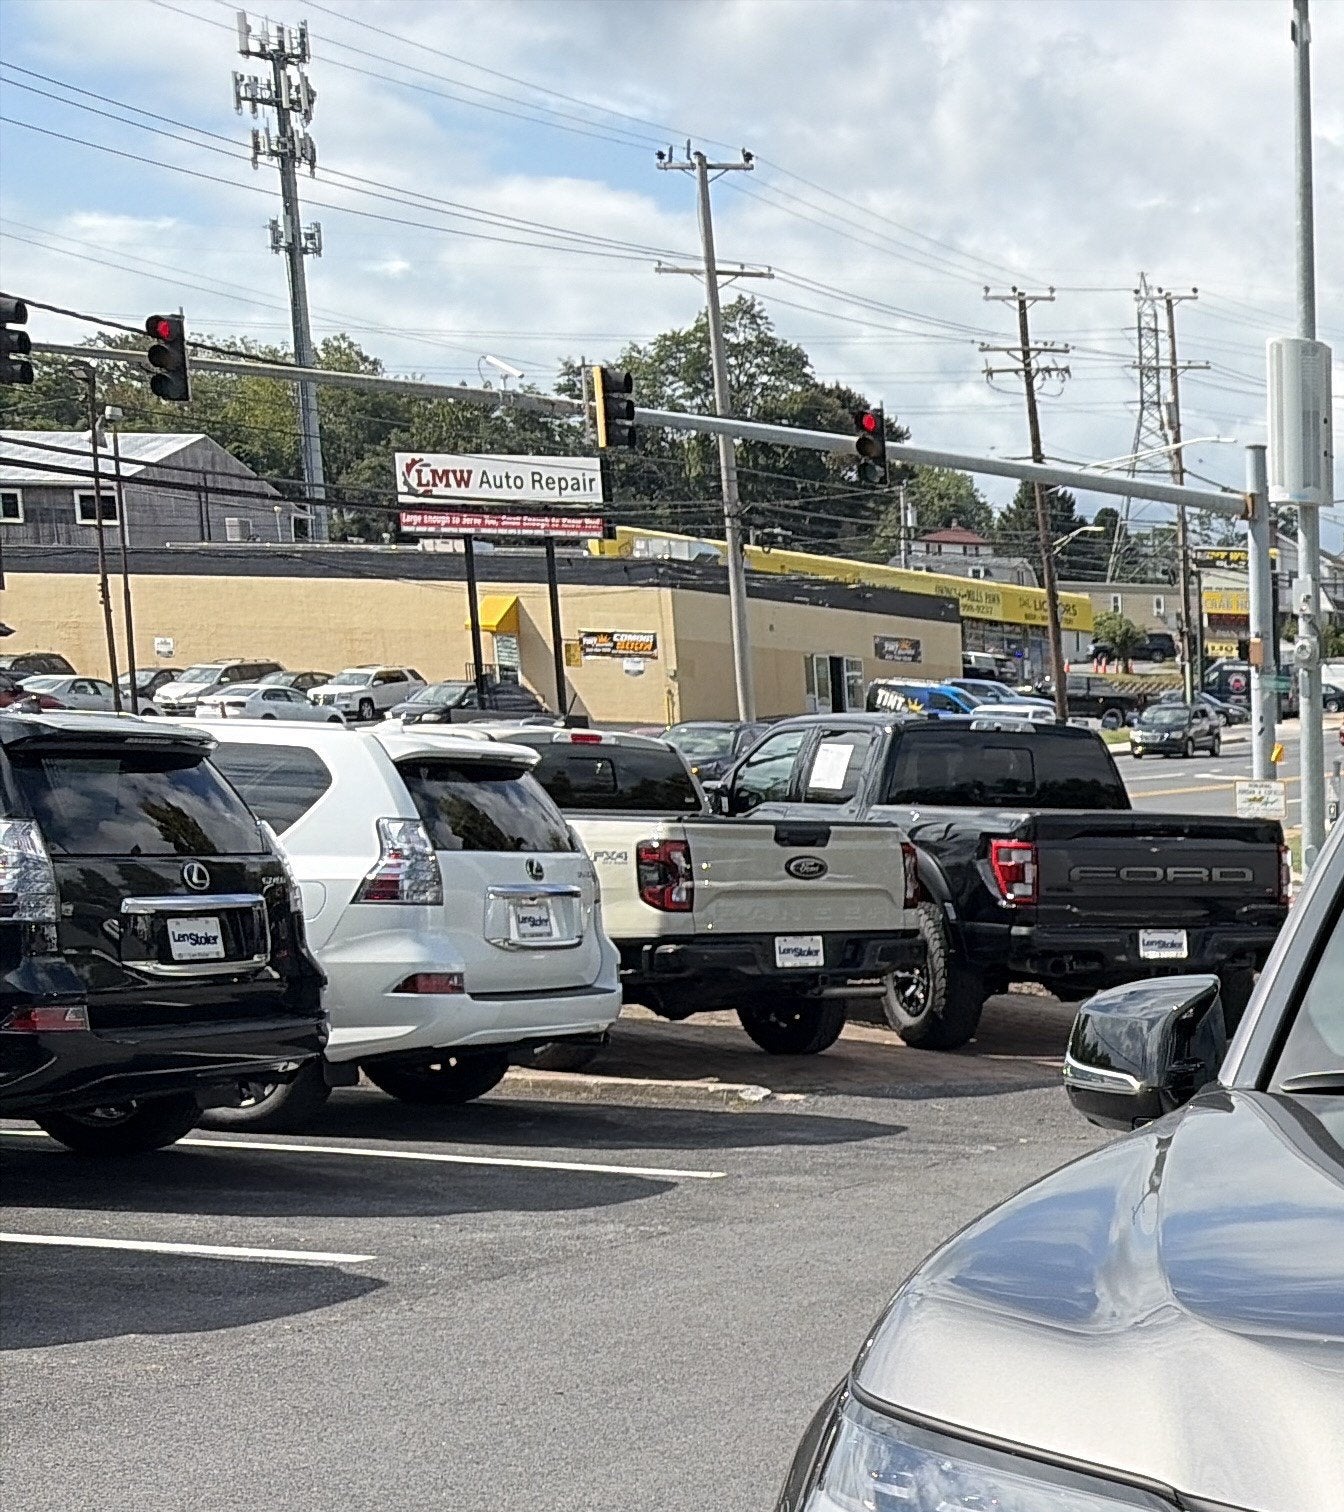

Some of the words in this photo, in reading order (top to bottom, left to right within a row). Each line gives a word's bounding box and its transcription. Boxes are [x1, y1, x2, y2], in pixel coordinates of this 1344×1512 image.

[415, 469, 473, 488] LMW
[479, 470, 524, 490] Auto
[531, 471, 596, 496] Repair
[877, 688, 905, 711] TINT
[593, 851, 628, 861] FX4
[1069, 866, 1254, 882] FORD
